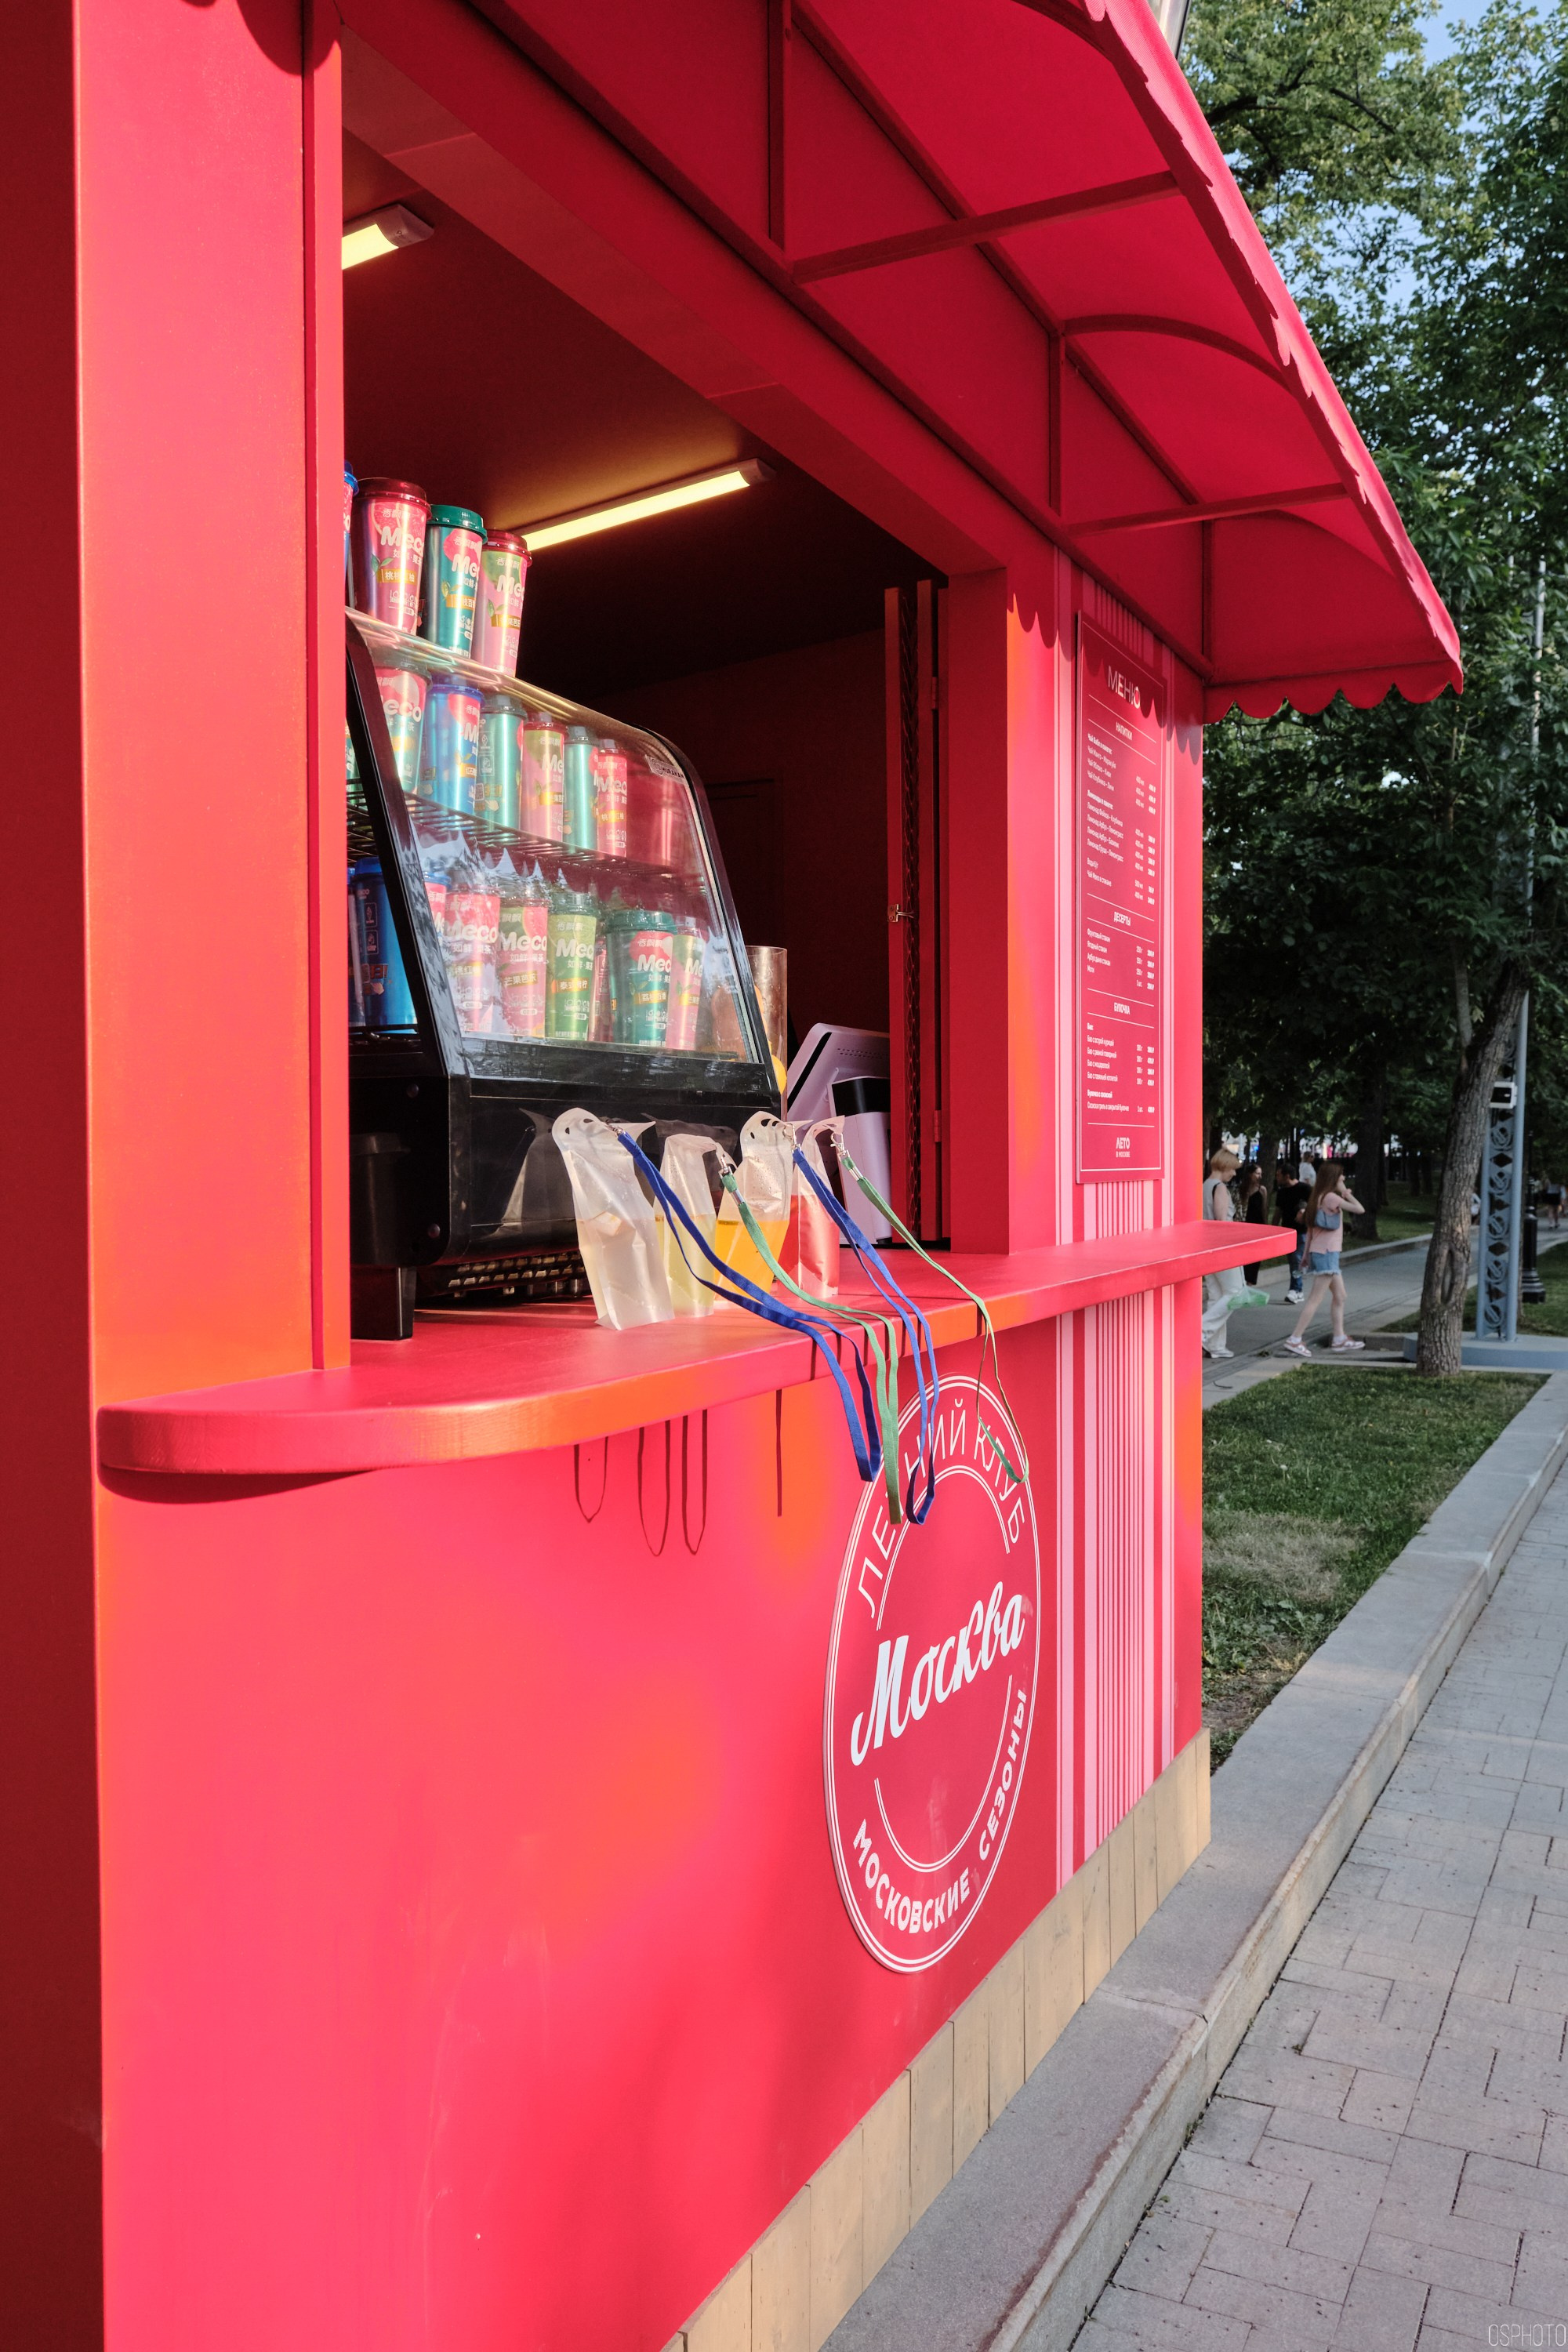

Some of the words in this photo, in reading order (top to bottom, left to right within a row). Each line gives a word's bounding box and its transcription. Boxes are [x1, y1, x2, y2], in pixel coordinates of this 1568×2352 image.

[385, 571, 415, 582] 桃桃柚
[1108, 665, 1141, 710] МЕНЮ
[381, 697, 422, 723] eco
[1116, 721, 1133, 741] НАПИТКИ
[1113, 911, 1131, 927] ДЕСЕРТЫ
[445, 920, 498, 943] Meco
[1113, 1001, 1131, 1016] БУЛОЧКА
[1116, 1137, 1130, 1149] ЛЕТО
[858, 1398, 967, 1620] ЛЕНИЙ
[973, 1420, 1025, 1544] КЛУБ
[851, 1580, 1025, 1767] Москва
[852, 1818, 971, 1935] МОСКОВСКИЕ
[978, 1687, 1028, 1860] СЕЗОНЫ
